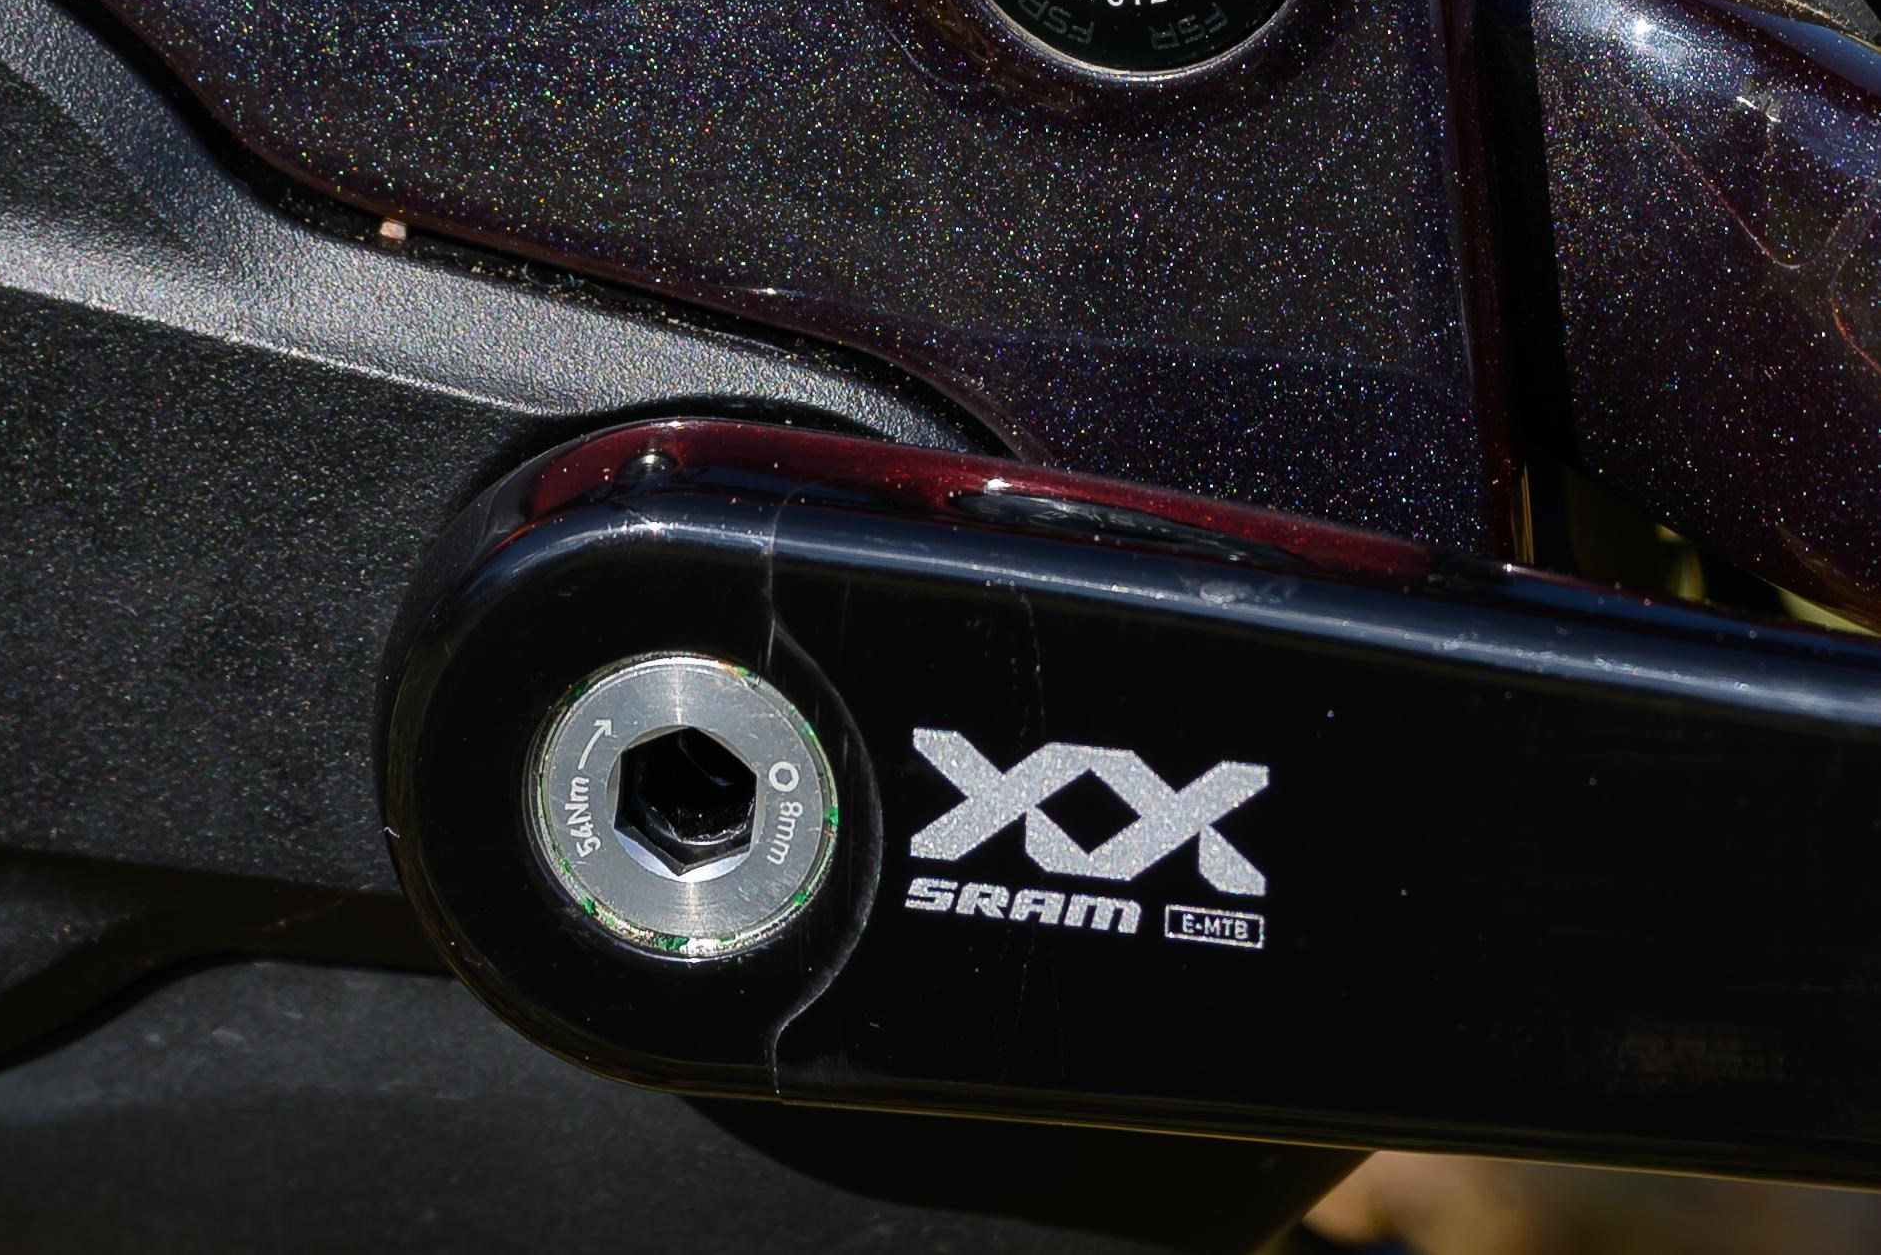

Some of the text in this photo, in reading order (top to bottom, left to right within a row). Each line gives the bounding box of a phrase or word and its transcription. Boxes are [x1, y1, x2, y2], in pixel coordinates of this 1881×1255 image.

[1149, 2, 1229, 51] FSR
[767, 801, 803, 865] 8mm
[910, 726, 1270, 897] XX
[904, 877, 1142, 934] SRAM
[1182, 912, 1249, 941] E-MTB
